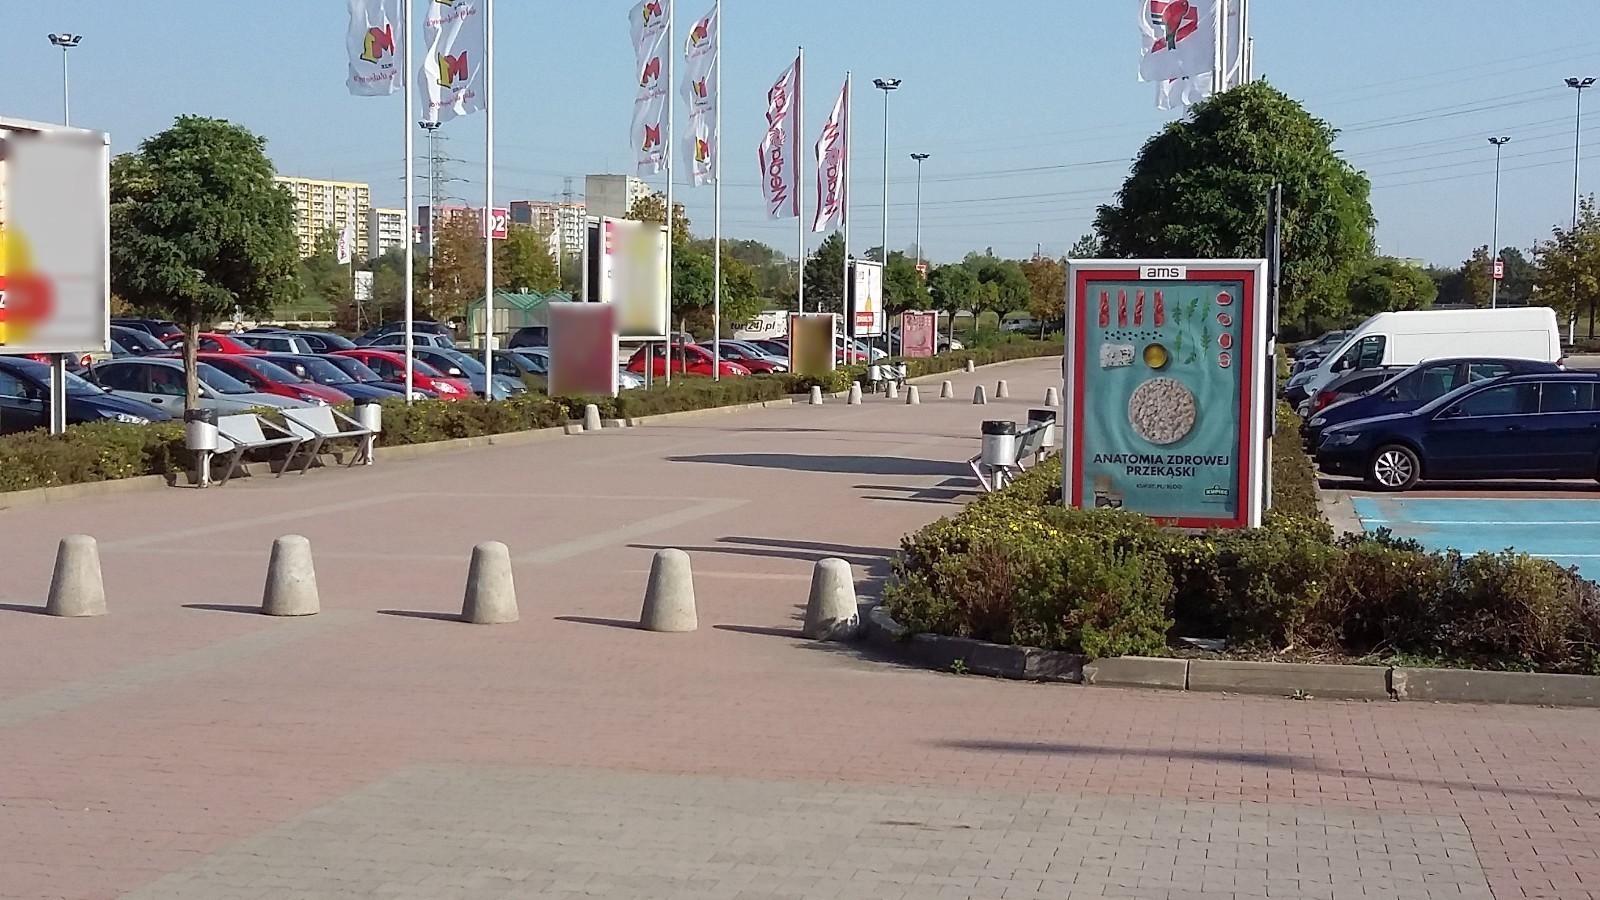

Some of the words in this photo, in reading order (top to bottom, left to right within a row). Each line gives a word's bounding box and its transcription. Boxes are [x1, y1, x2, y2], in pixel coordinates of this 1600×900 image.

[1147, 267, 1180, 279] ams
[1093, 454, 1163, 464] ANATOMIA
[1167, 455, 1229, 466] ZDROWEJ
[1126, 466, 1196, 478] PRZEKĄSKI
